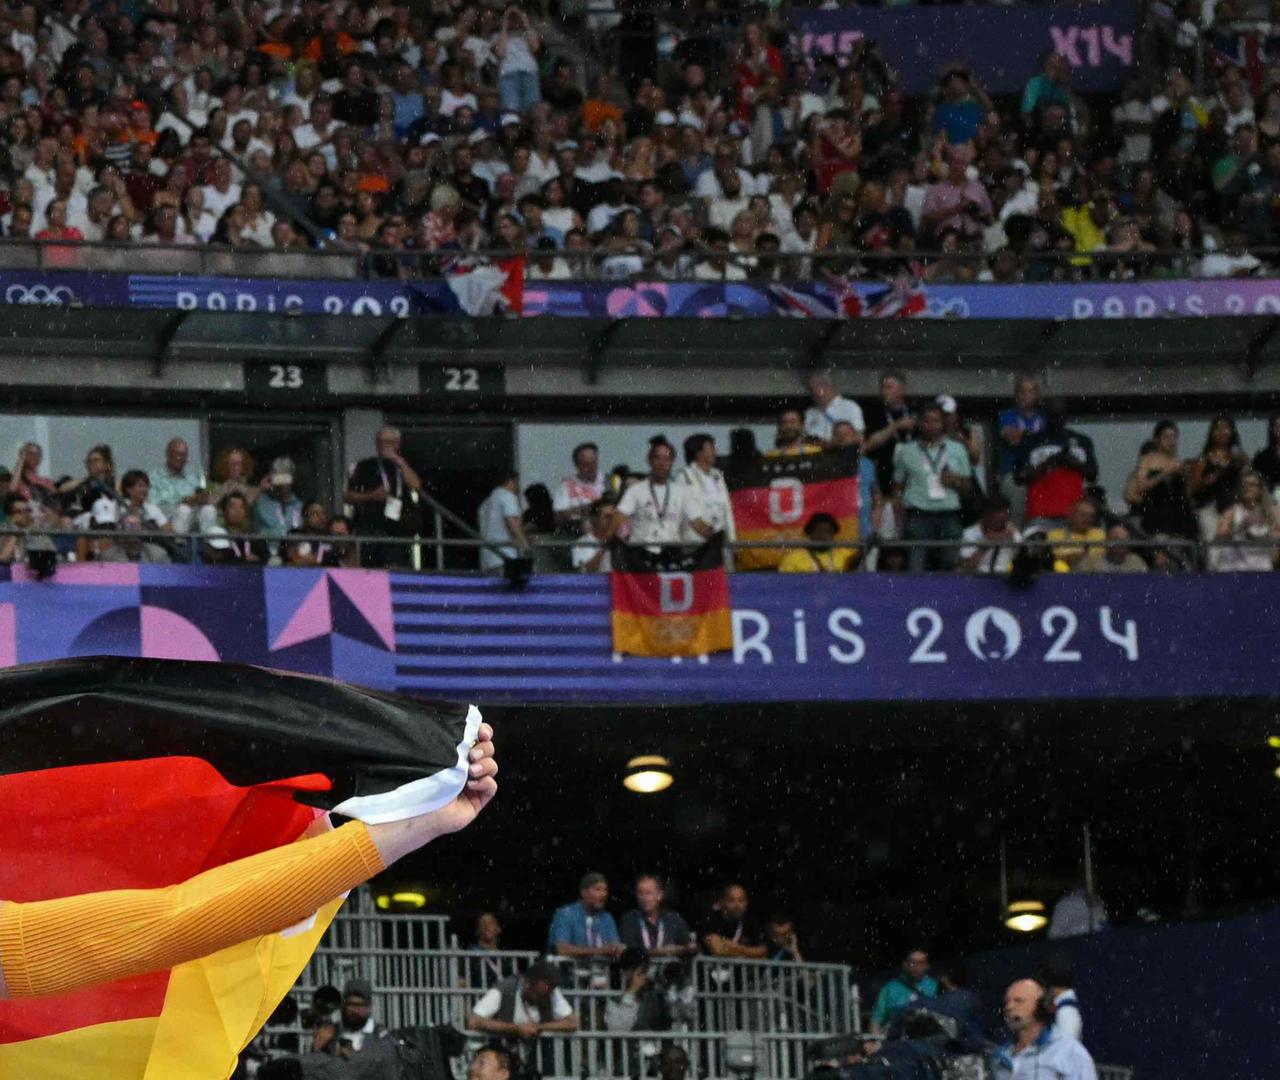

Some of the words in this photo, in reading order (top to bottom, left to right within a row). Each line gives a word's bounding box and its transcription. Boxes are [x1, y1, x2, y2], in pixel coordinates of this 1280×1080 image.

[1049, 25, 1134, 67] X14
[269, 365, 304, 388] 23
[445, 368, 480, 390] 22
[657, 571, 694, 614] D
[906, 606, 1139, 662] 2024
